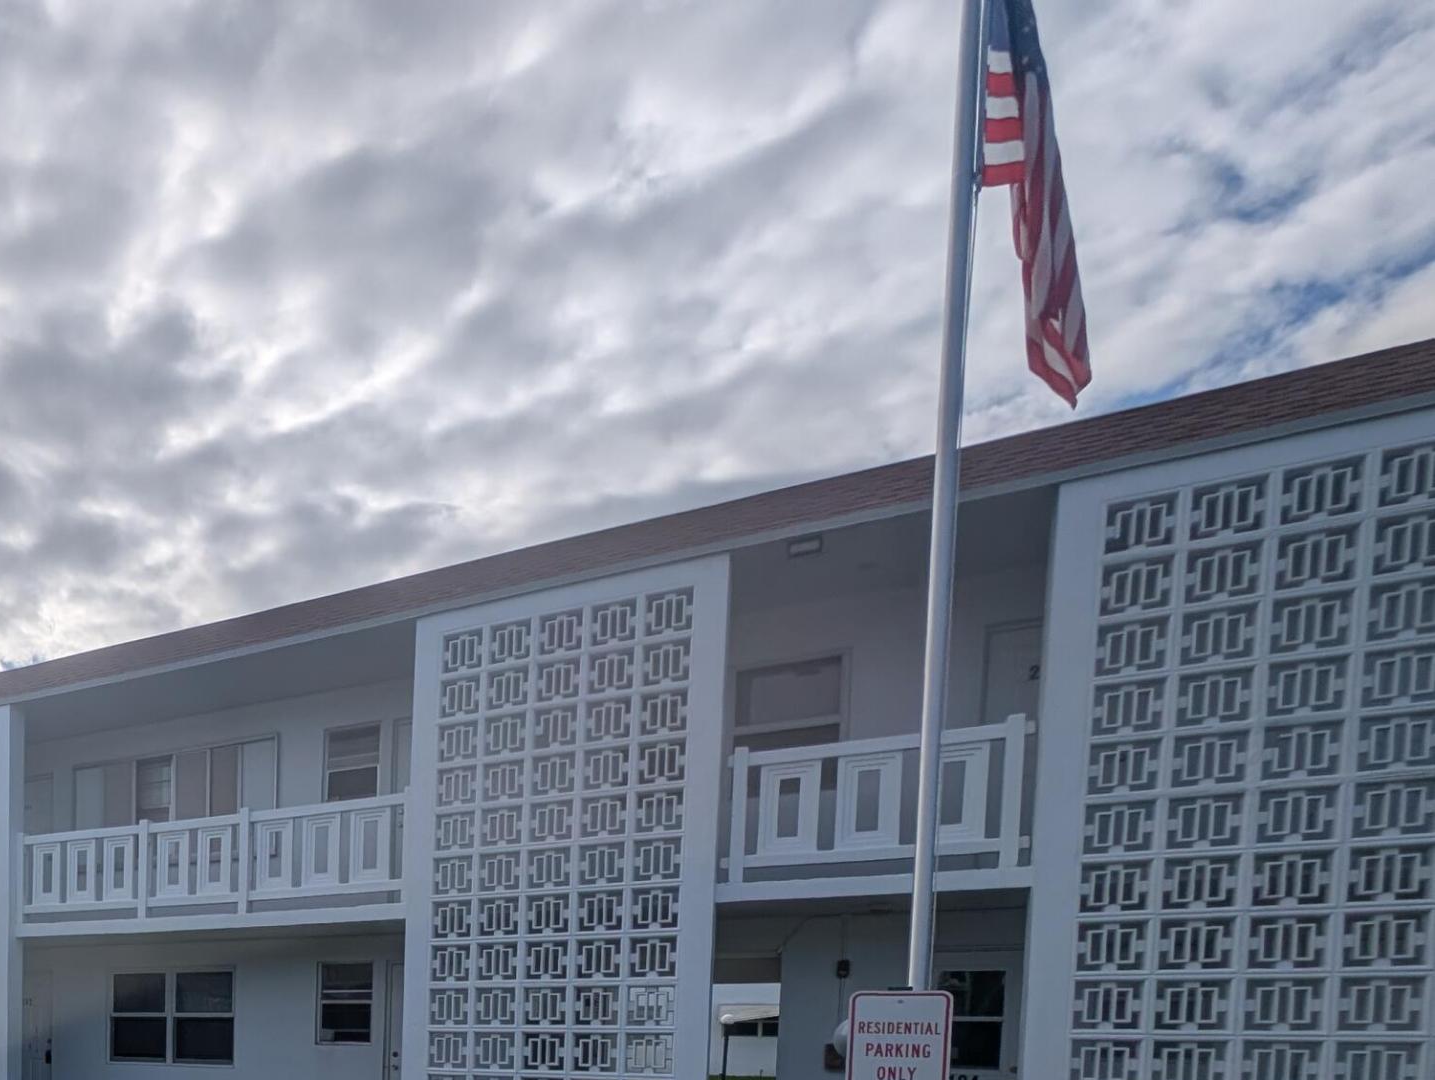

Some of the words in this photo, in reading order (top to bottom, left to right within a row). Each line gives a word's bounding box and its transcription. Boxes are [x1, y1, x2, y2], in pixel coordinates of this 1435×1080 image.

[858, 1022, 941, 1035] RESIDENTIAL
[865, 1043, 931, 1058] PARKING
[877, 1066, 917, 1080] ONLY
